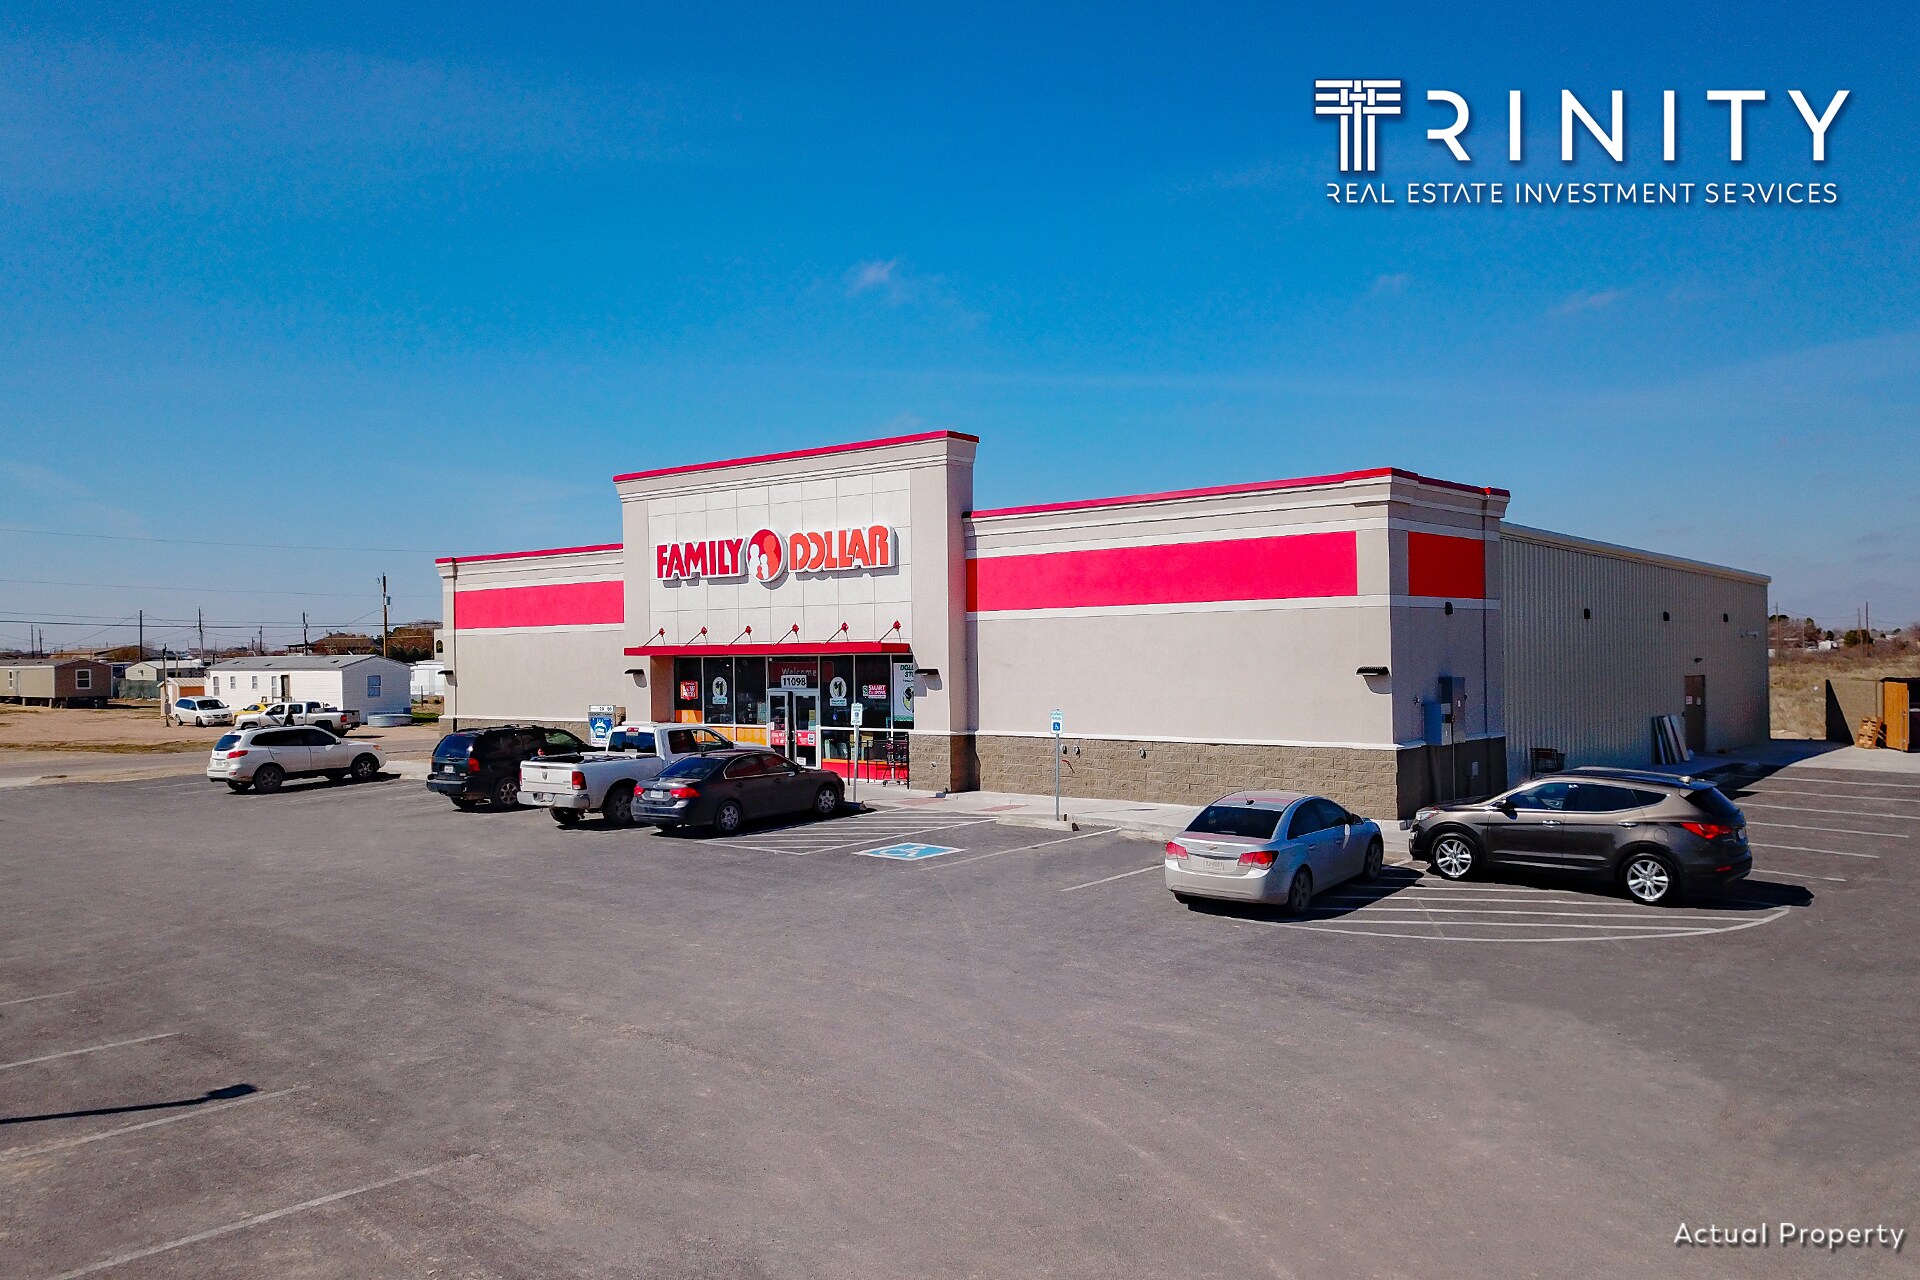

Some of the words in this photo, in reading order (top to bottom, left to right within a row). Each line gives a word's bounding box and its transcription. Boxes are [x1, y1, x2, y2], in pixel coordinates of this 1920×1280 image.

[656, 538, 744, 579] FAMILY
[789, 525, 889, 571] DOLLAR
[782, 677, 807, 687] 11098
